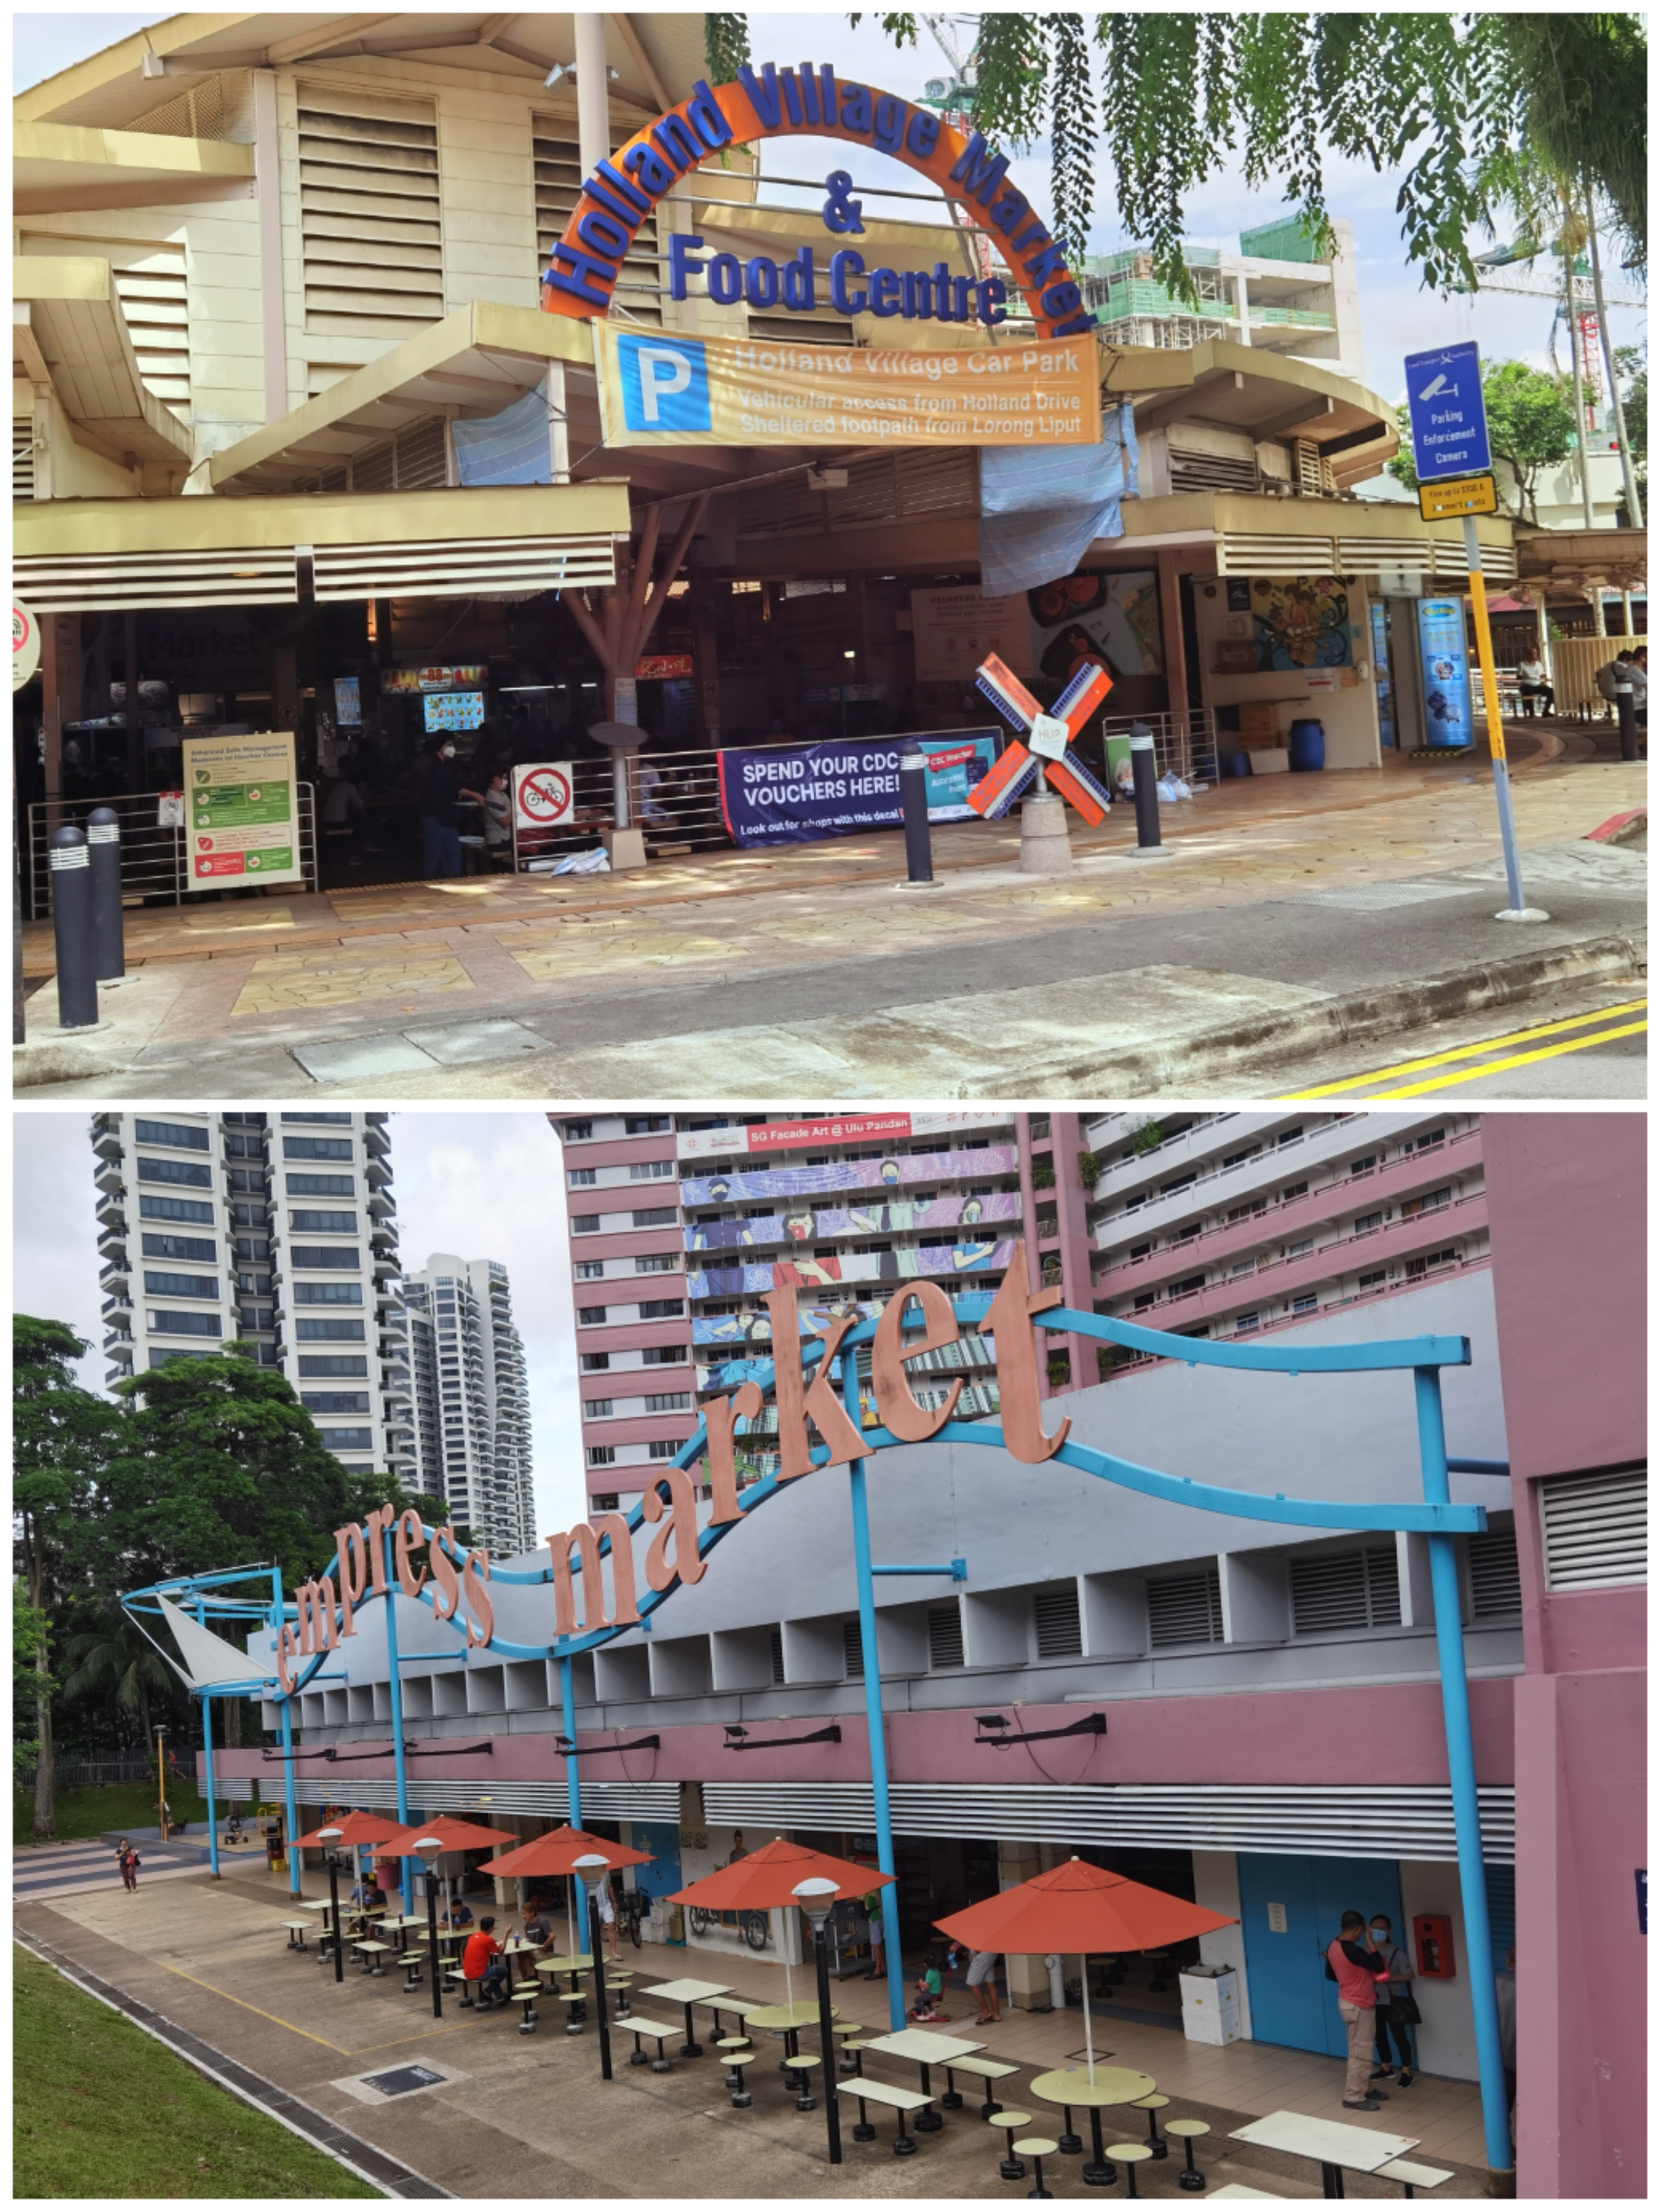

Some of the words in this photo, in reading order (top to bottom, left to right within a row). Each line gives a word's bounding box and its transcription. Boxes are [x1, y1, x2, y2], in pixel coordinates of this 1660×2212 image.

[543, 79, 733, 306] Holland
[735, 61, 941, 158] Village
[949, 131, 1099, 338] Market
[822, 170, 865, 234] &
[669, 233, 815, 311] Food
[829, 250, 1007, 325] Centre
[735, 346, 853, 373] Holland
[865, 351, 958, 380] Village
[967, 351, 1011, 374] Car
[1022, 349, 1079, 373] Park
[637, 347, 692, 422] P
[737, 389, 835, 410] Vehicular
[842, 396, 908, 411] access
[914, 393, 956, 412] from
[962, 393, 1031, 412] Holland
[1036, 393, 1081, 411] Drive
[740, 413, 835, 434] Sheltered
[841, 415, 919, 438] footpath
[925, 416, 966, 434] from
[972, 416, 1034, 438] Lorong
[1038, 416, 1081, 436] Liput
[1431, 409, 1463, 425] Parking
[1423, 426, 1476, 446] Enforcement
[1435, 450, 1468, 463] Camera
[149, 628, 262, 659] Market
[742, 760, 805, 783] SPEND
[808, 755, 859, 776] YOUR
[862, 751, 898, 771] CDC
[930, 756, 945, 766] CDC
[743, 780, 846, 806] VOUCHERS
[850, 773, 900, 797] HERE!
[740, 823, 766, 835] Look
[768, 821, 785, 832] out
[785, 819, 799, 831] for
[802, 815, 832, 829] shops
[833, 814, 854, 825] with
[854, 812, 872, 823] this
[873, 810, 899, 821] decal
[751, 1132, 768, 1142] SG
[771, 1129, 809, 1140] Facade
[812, 1126, 828, 1137] Art
[831, 1124, 843, 1137] @
[845, 1124, 864, 1134] Ulu
[866, 1119, 908, 1131] Pandan
[277, 1503, 494, 1694] empress
[547, 1242, 1070, 1637] market
